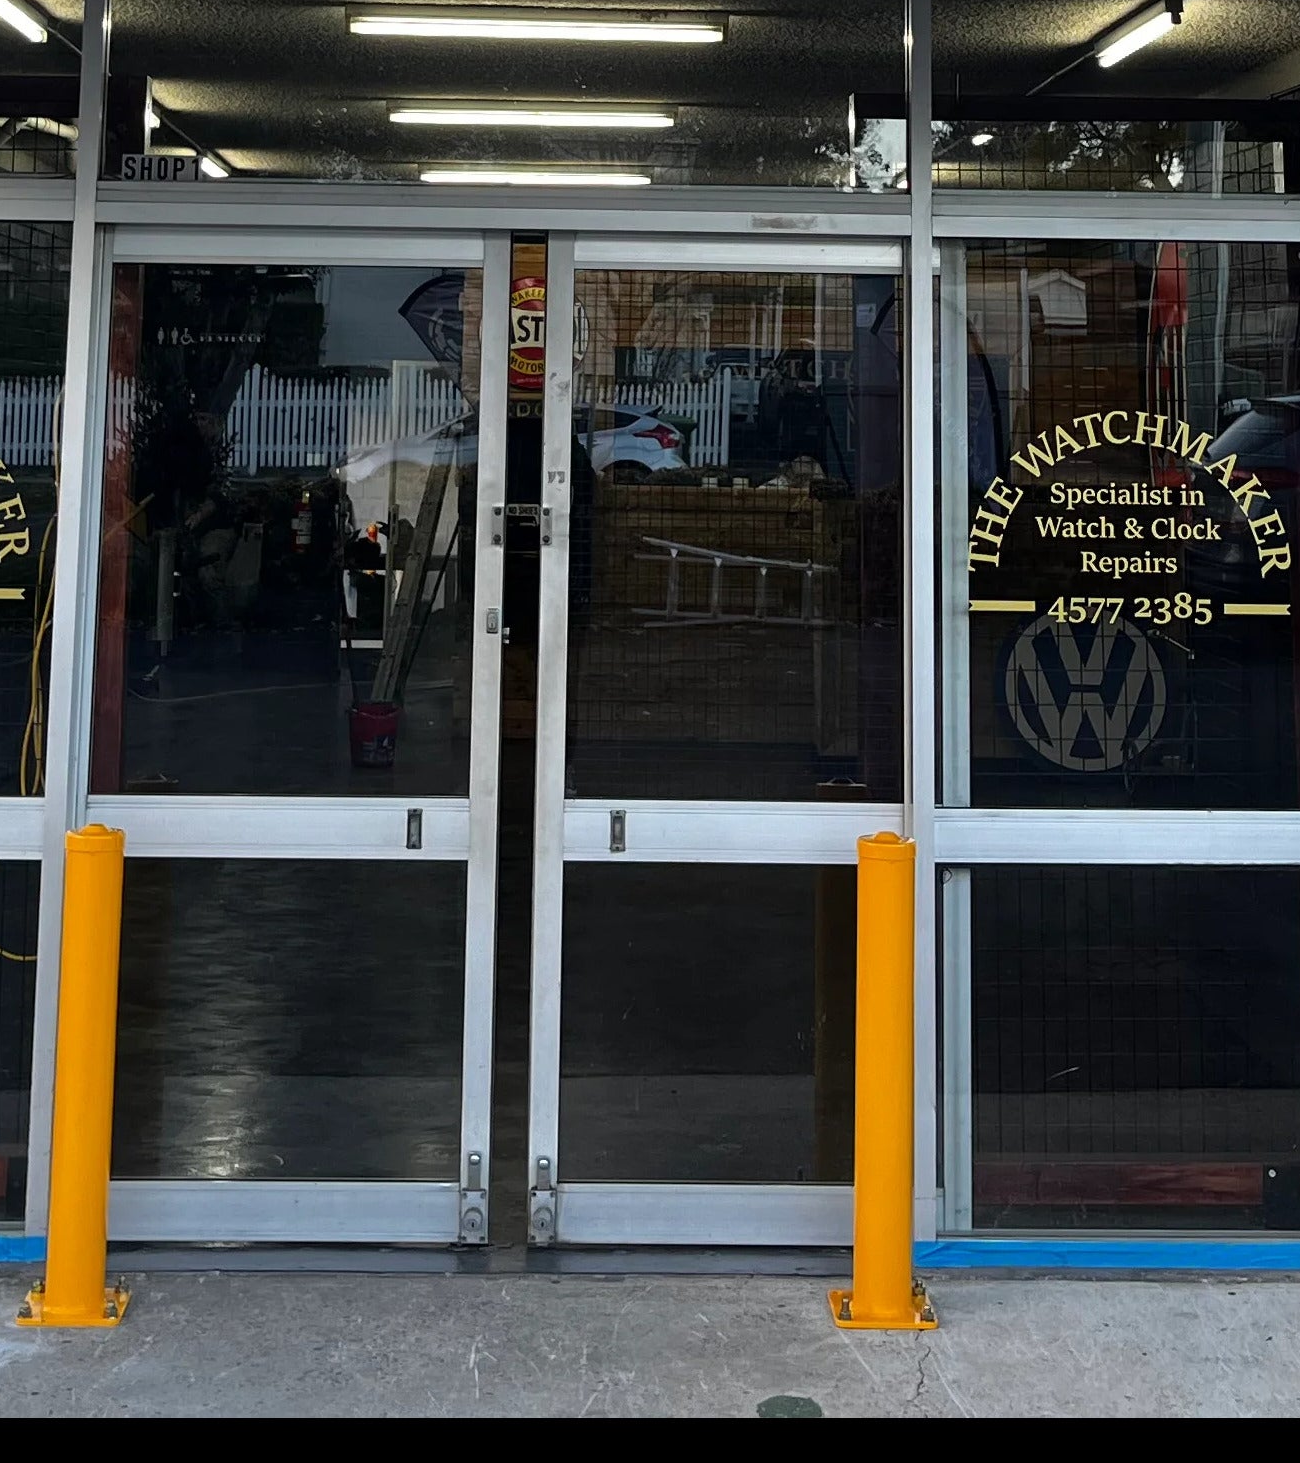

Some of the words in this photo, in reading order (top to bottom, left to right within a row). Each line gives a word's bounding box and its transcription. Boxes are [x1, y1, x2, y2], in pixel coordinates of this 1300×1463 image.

[969, 475, 1024, 573] THE
[1010, 409, 1292, 580] WATCHMAKER
[1050, 482, 1173, 510] Specialist
[1179, 483, 1205, 507] in
[1035, 515, 1116, 540] Watch
[1123, 518, 1145, 540] &
[1151, 517, 1222, 541] Clock
[1080, 550, 1178, 580] Repairs
[1046, 596, 1125, 624] 4577
[1133, 592, 1213, 625] 2385
